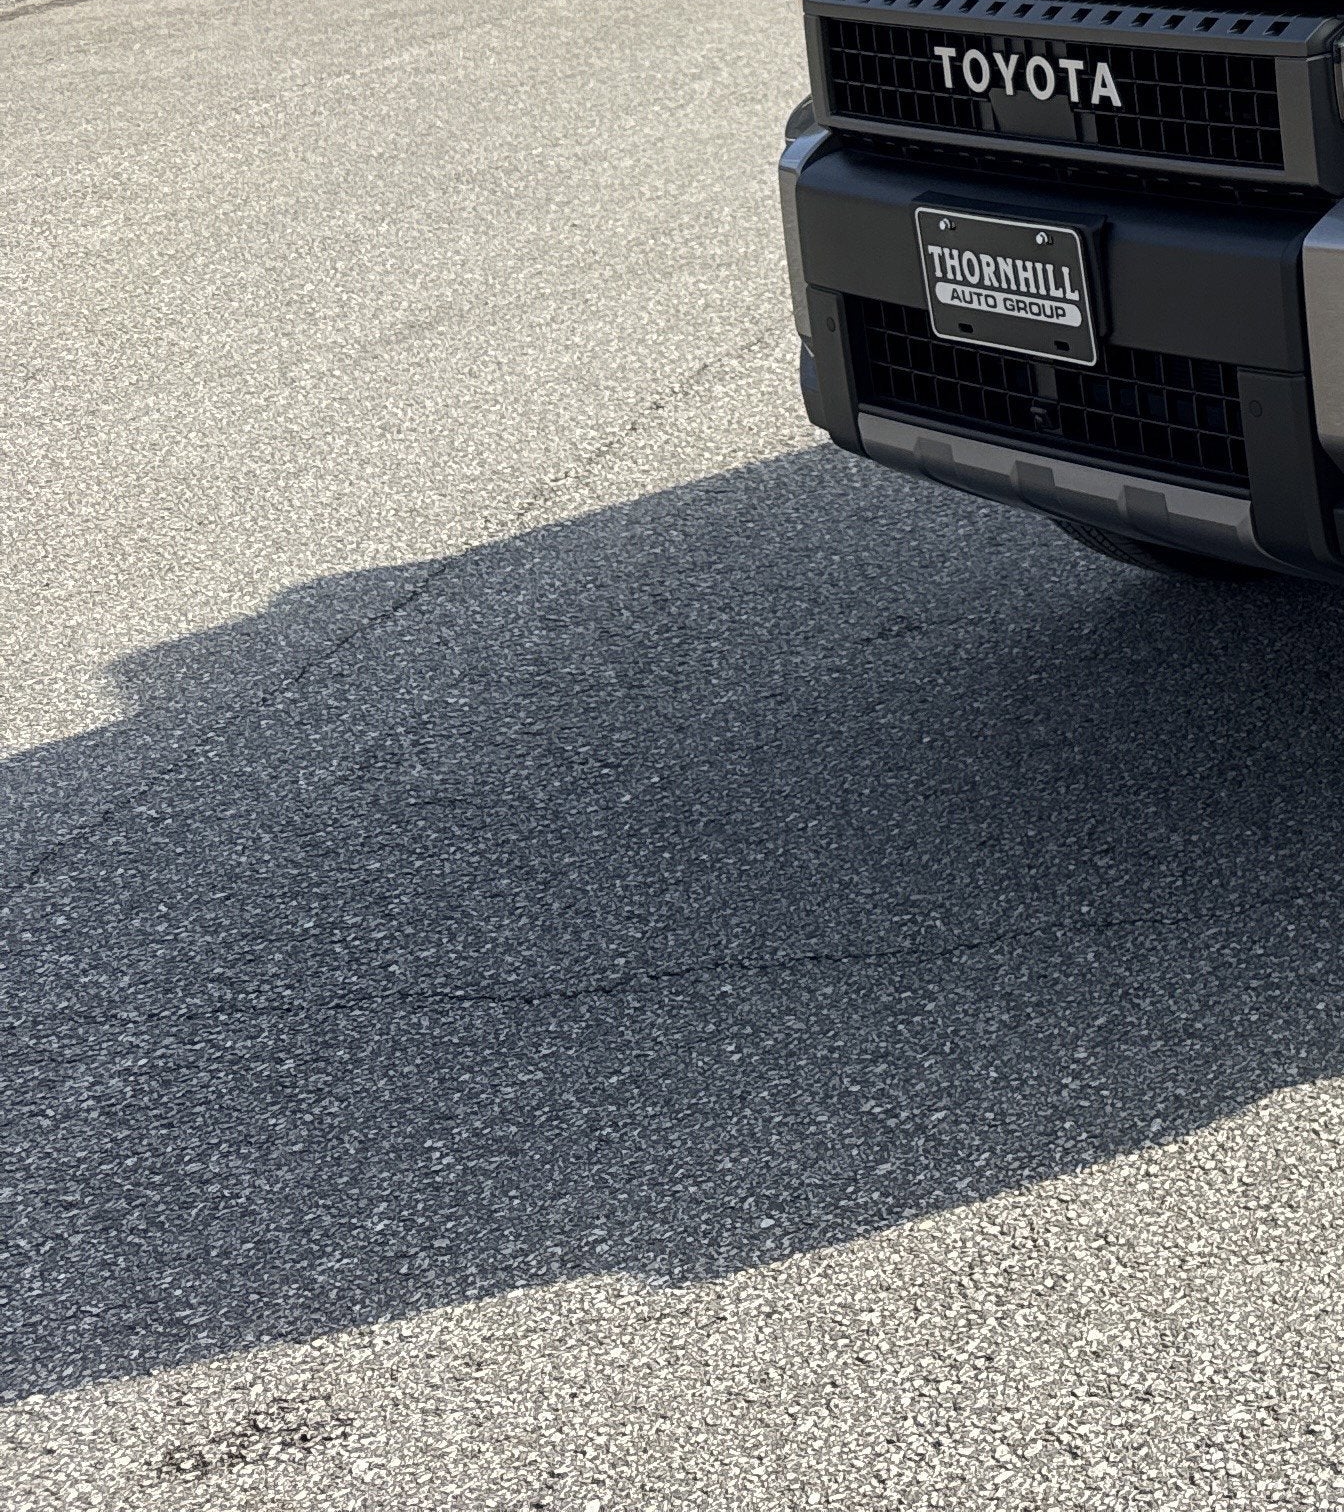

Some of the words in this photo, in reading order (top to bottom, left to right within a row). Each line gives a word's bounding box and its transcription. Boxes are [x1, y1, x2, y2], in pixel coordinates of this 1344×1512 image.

[933, 45, 1123, 109] TOYOTA
[927, 244, 1080, 302] THORNHILL
[949, 288, 998, 312] AUTO
[1002, 296, 1067, 321] GROUP
